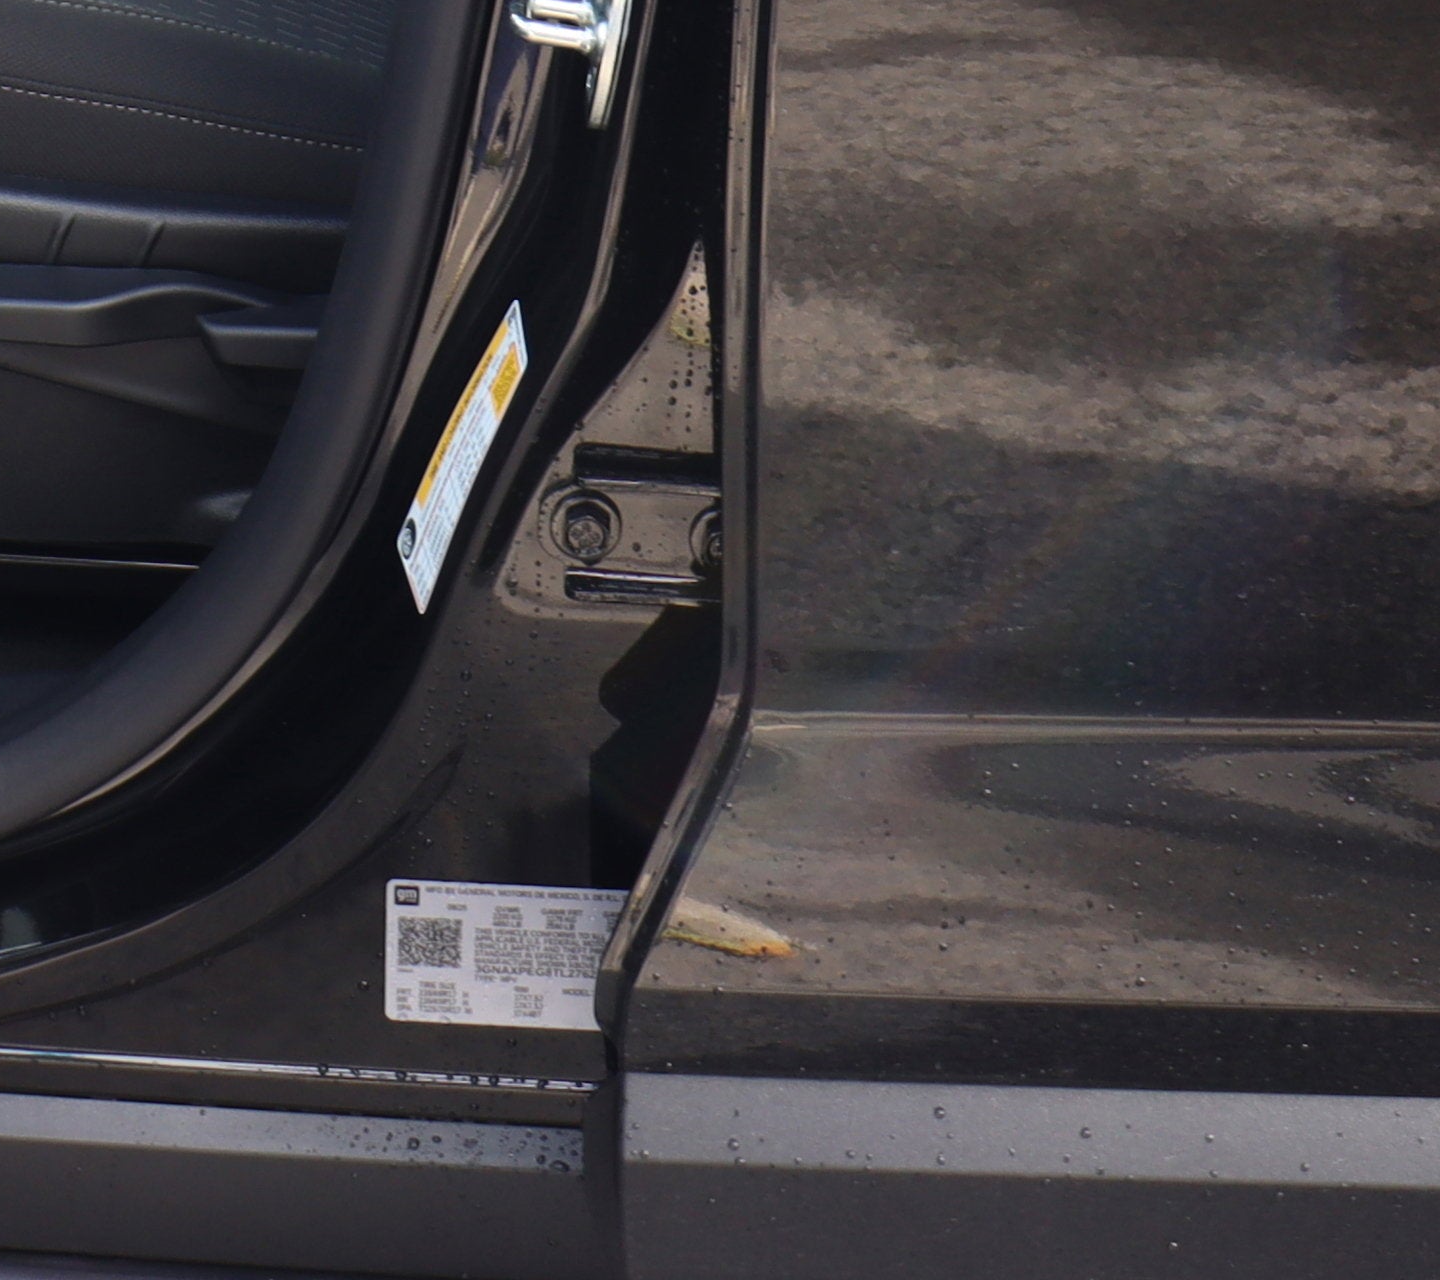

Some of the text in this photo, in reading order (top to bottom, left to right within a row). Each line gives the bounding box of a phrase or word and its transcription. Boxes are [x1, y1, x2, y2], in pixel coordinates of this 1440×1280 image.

[396, 888, 417, 901] gm
[458, 888, 494, 897] GENERAL
[498, 890, 532, 899] MOTORS
[534, 891, 545, 899] DE
[593, 893, 604, 901] DE
[475, 927, 493, 935] THIS
[530, 930, 576, 938] CONFORMS
[475, 942, 508, 950] VEHICLE
[543, 938, 579, 946] FEDERAL
